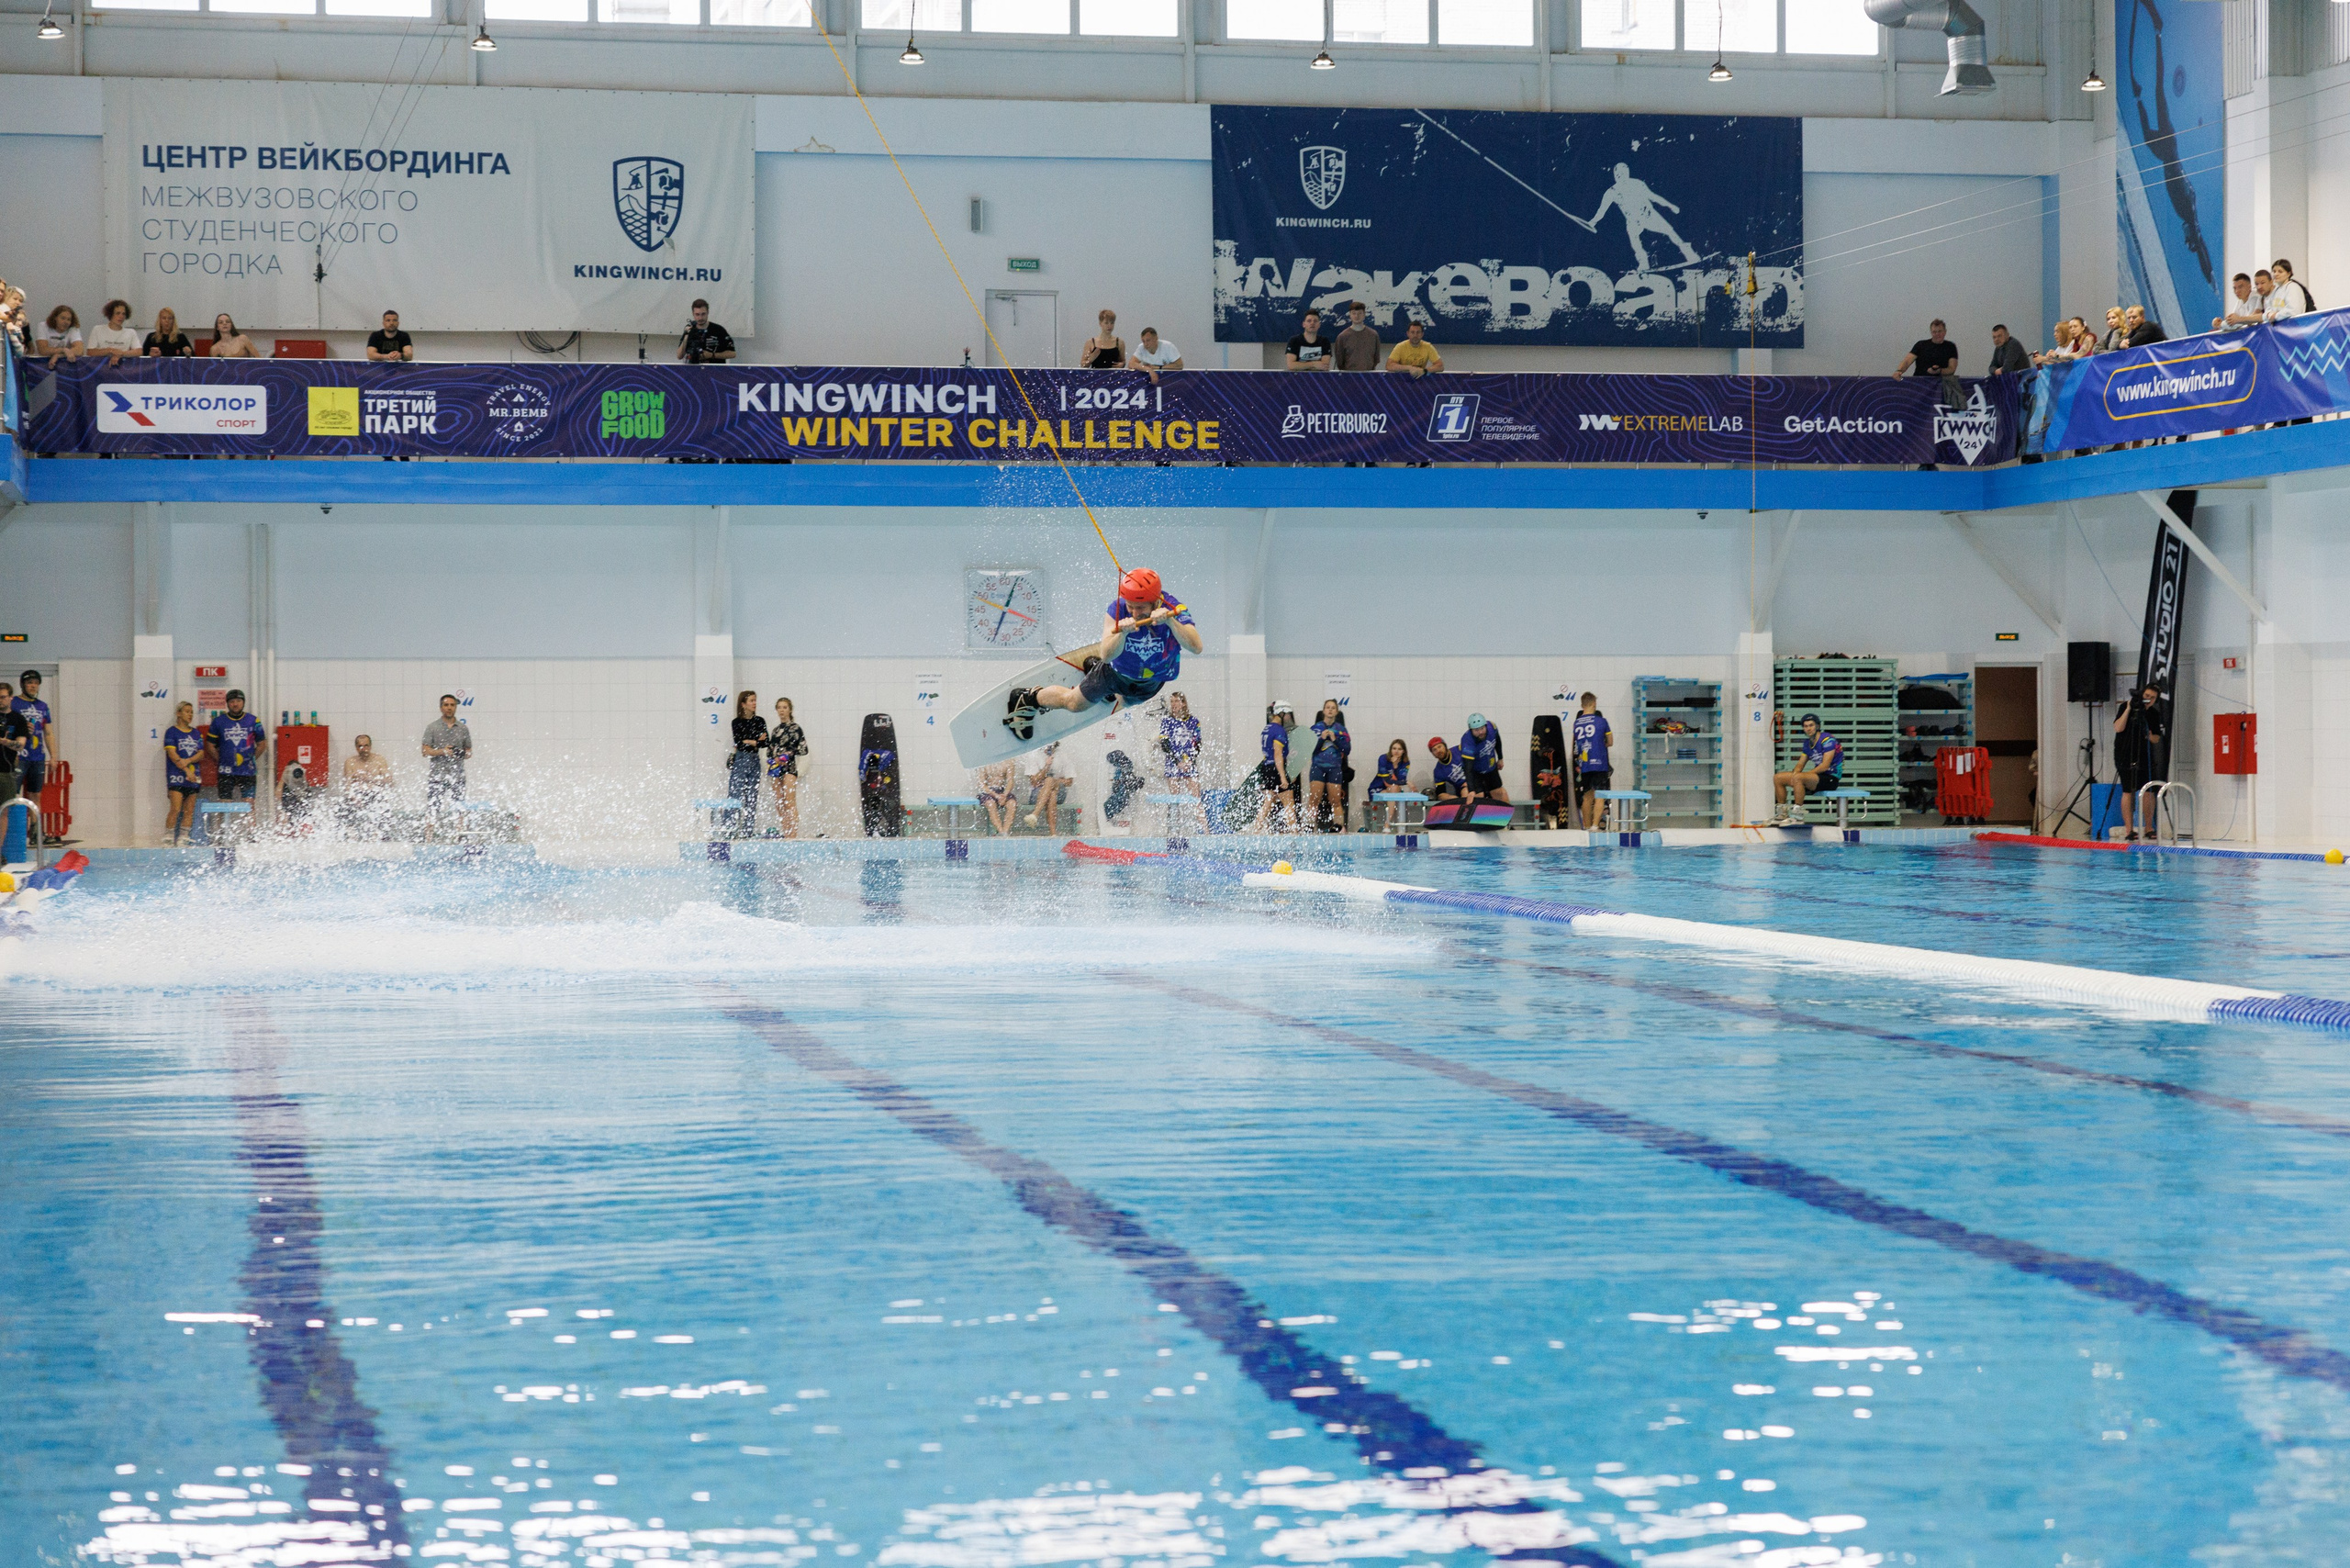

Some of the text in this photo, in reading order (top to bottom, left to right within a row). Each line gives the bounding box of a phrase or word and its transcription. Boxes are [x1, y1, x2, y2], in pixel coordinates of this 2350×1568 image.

[141, 141, 511, 179] ЦЕНТР ВЕЙКБОРДИНГА
[141, 185, 419, 212] МЕЖВУЗОВСКОГО
[141, 218, 398, 246] СТУДЕНЧЕСКОГО
[1276, 217, 1371, 229] KINGWINCH.RU
[142, 252, 284, 279] ГОРОДКА
[574, 264, 722, 282] KINGWINCH.RU
[2116, 367, 2237, 403] www.kingwinch.ru
[140, 396, 257, 412] ТРИКОЛОР
[486, 383, 552, 407] TRAVEL ENERGY
[737, 382, 997, 414] KINGWINCH
[364, 396, 437, 413] ТРЕТИЙ
[488, 408, 548, 418] MR.BEMB
[601, 390, 666, 420] GROW
[216, 419, 257, 429] СПОРТ
[364, 414, 437, 434] ПАРК
[601, 409, 666, 439] FOOD
[1306, 412, 1387, 434] PETERBURG2
[1624, 415, 1744, 431] EXTREMELAB
[1784, 415, 1903, 433] GetAction
[1937, 420, 1996, 441] KWWCH
[495, 426, 544, 442] SINCE 2022
[781, 416, 1221, 450] WINTER CHALLENGE
[2155, 542, 2179, 680] STUDIO 21
[203, 667, 218, 676] ПК
[711, 713, 719, 724] 3
[926, 716, 934, 725] 4
[1561, 711, 1569, 722] 7
[1753, 711, 1762, 721] 8
[151, 728, 158, 738] 1
[1575, 724, 1595, 740] 29
